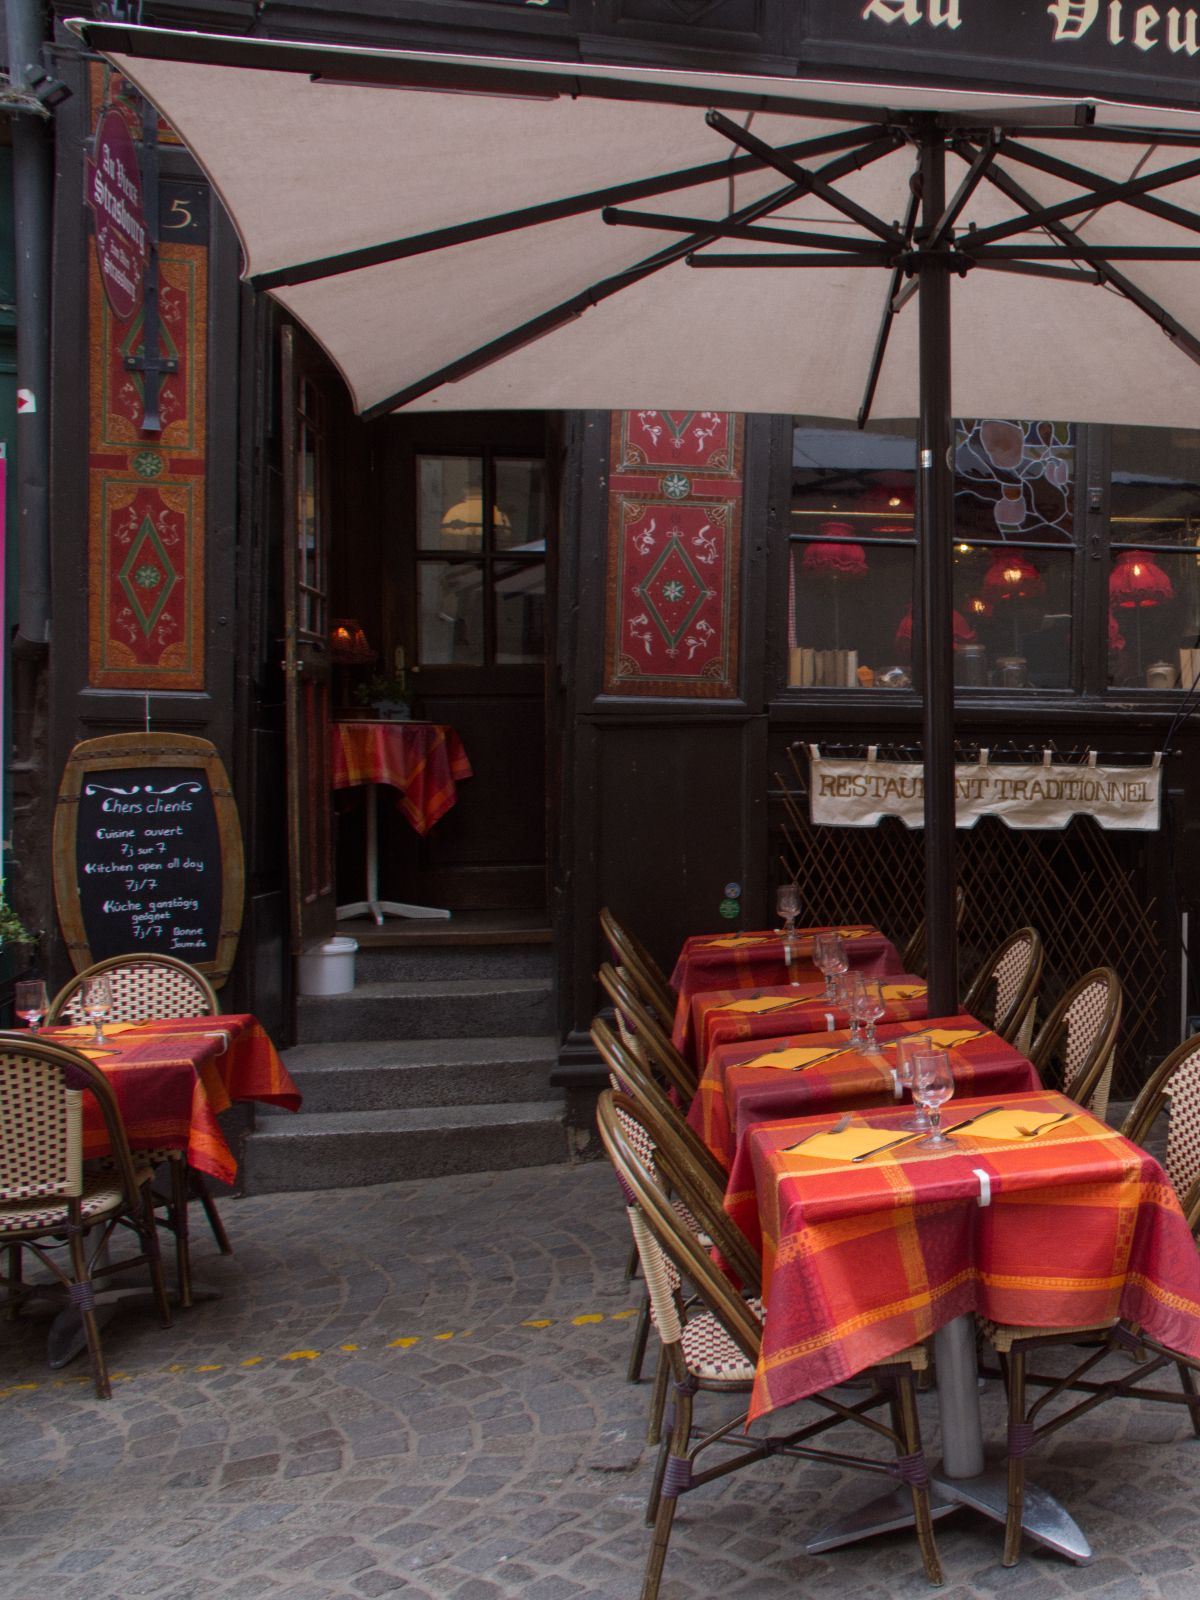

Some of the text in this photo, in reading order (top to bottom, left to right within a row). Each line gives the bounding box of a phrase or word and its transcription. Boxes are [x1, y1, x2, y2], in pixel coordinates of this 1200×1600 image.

[94, 169, 146, 256] Strasbourg
[819, 774, 1155, 802] RESTAUNT TRADITIONNEL
[102, 798, 193, 813] Chers clients
[97, 826, 184, 840] Cuisine ouvert
[137, 847, 154, 855] sur
[156, 842, 167, 853] 7
[85, 858, 204, 874] Kitchen open all day
[103, 900, 142, 913] Küche
